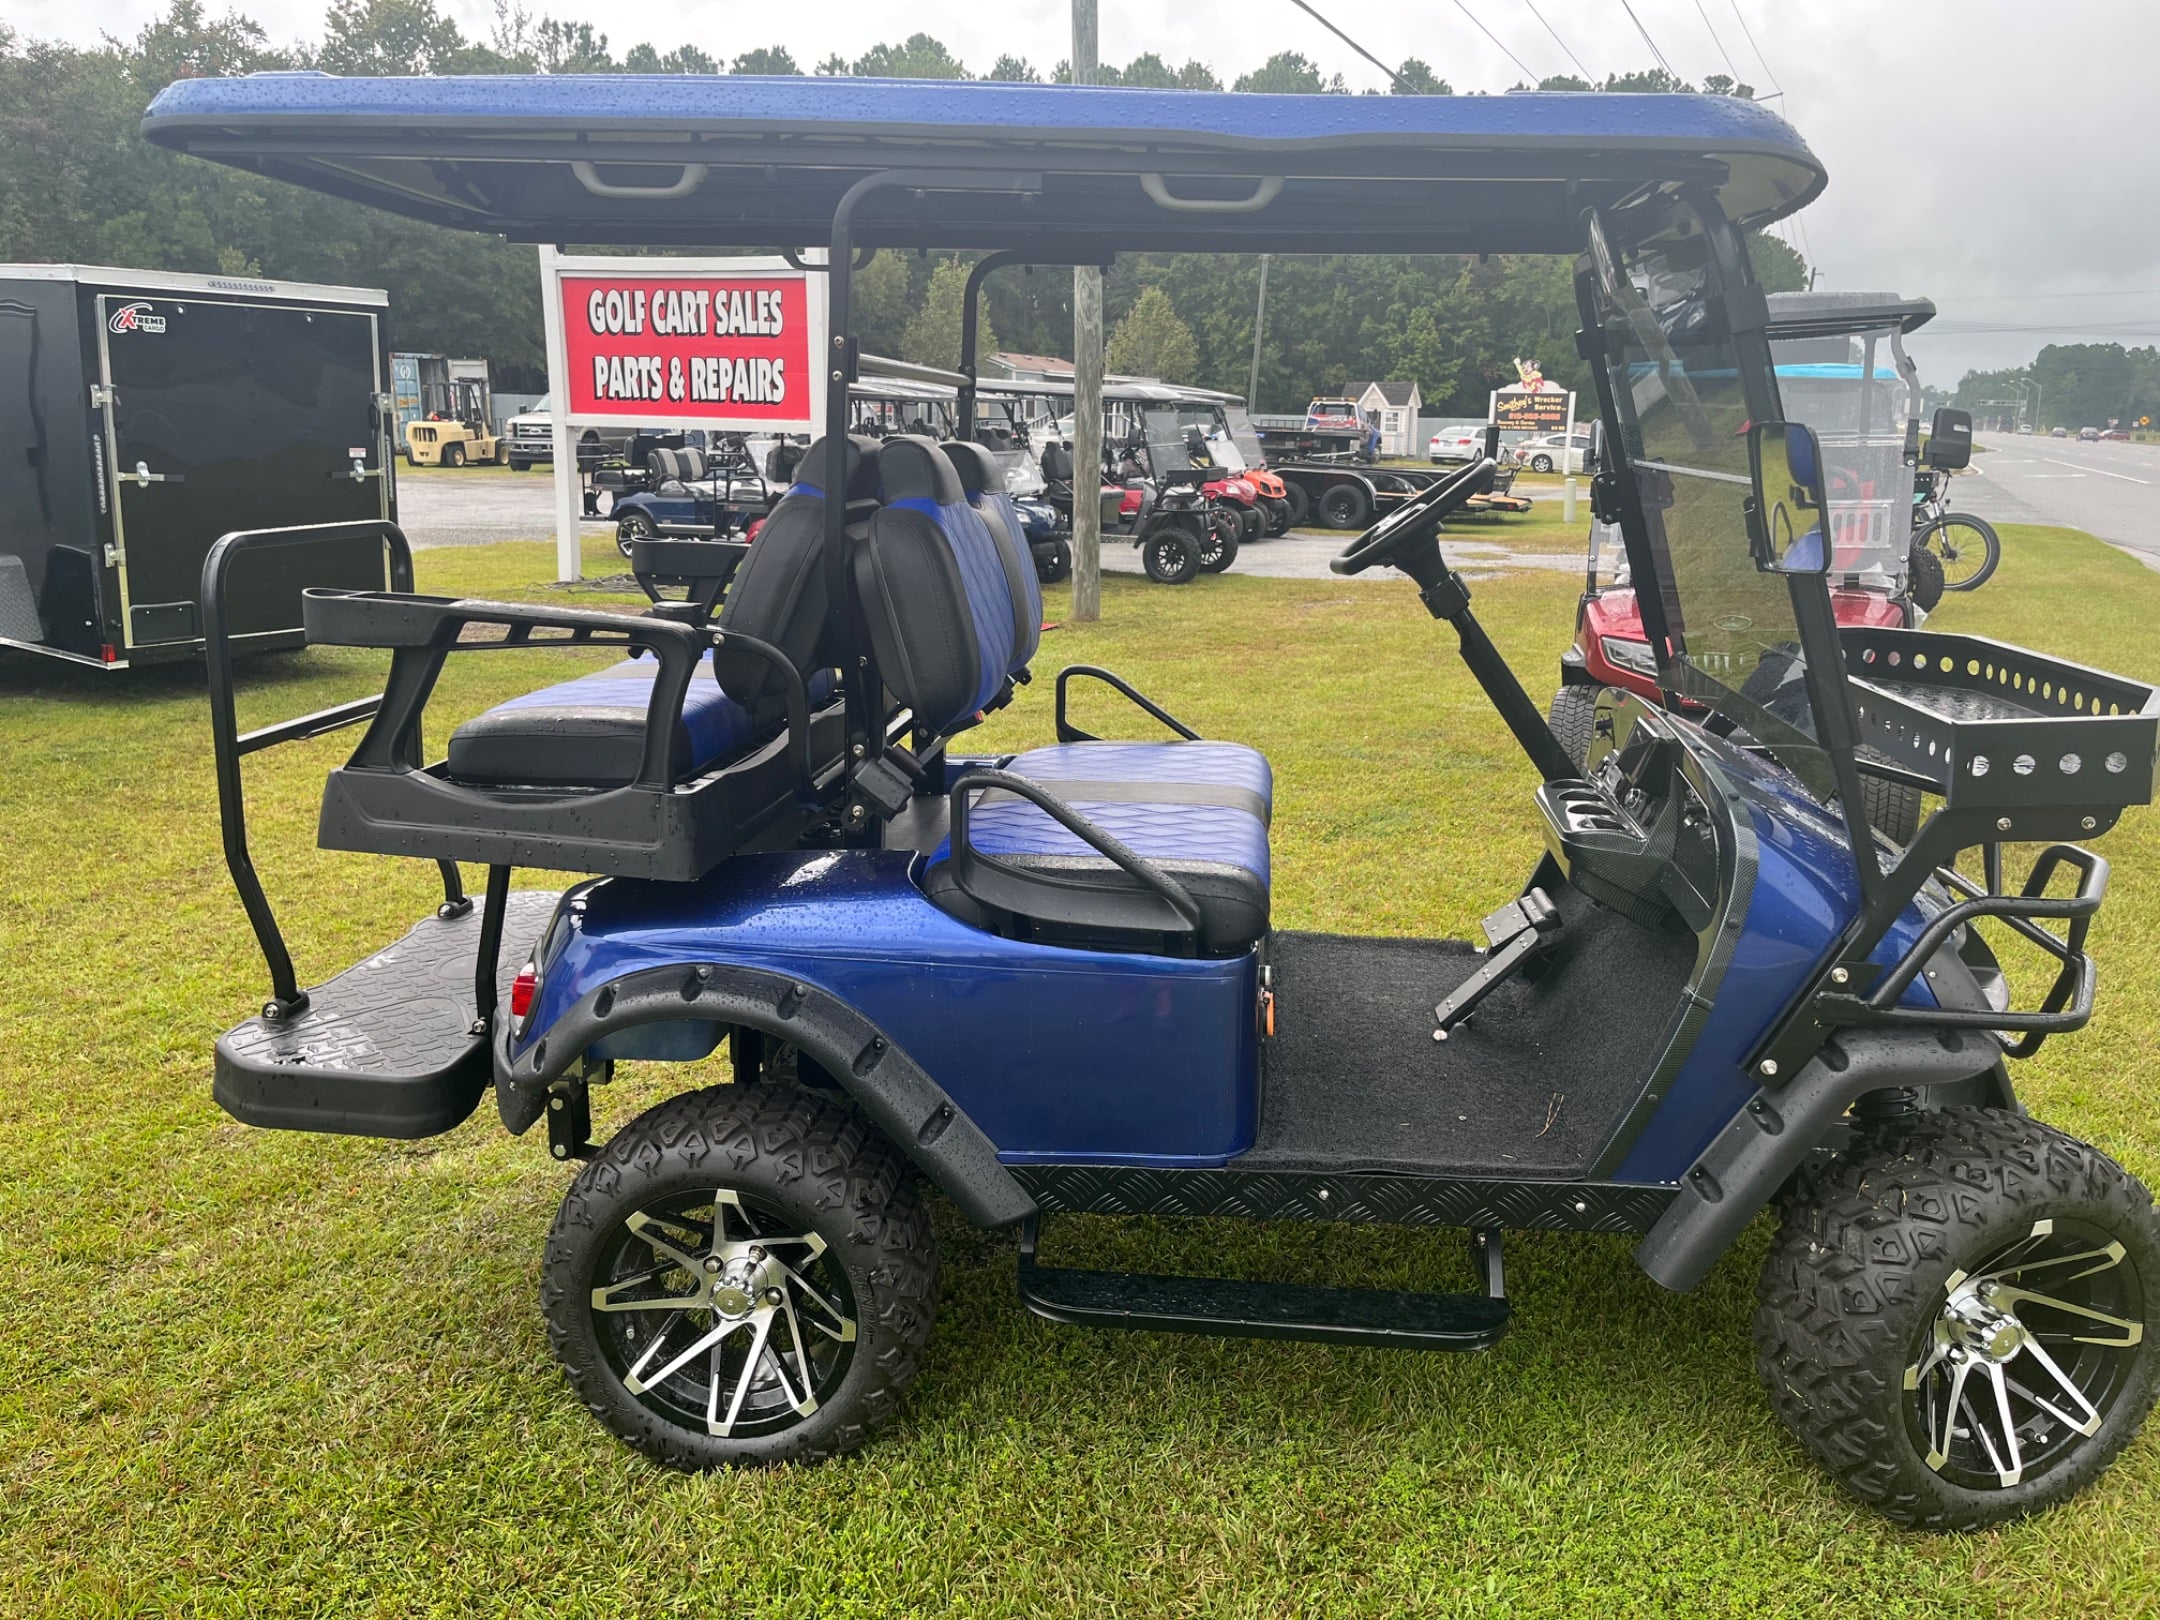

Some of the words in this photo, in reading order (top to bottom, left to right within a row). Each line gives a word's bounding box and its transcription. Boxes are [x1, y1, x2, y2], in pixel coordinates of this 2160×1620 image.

[119, 309, 165, 329] XTREME
[588, 288, 646, 336] GOLF
[650, 288, 709, 336] CART
[714, 289, 784, 337] SALES
[593, 355, 663, 400] PARTS
[668, 357, 685, 402] &
[690, 357, 785, 404] REPAIRS
[848, 1266, 878, 1336] KENDA
